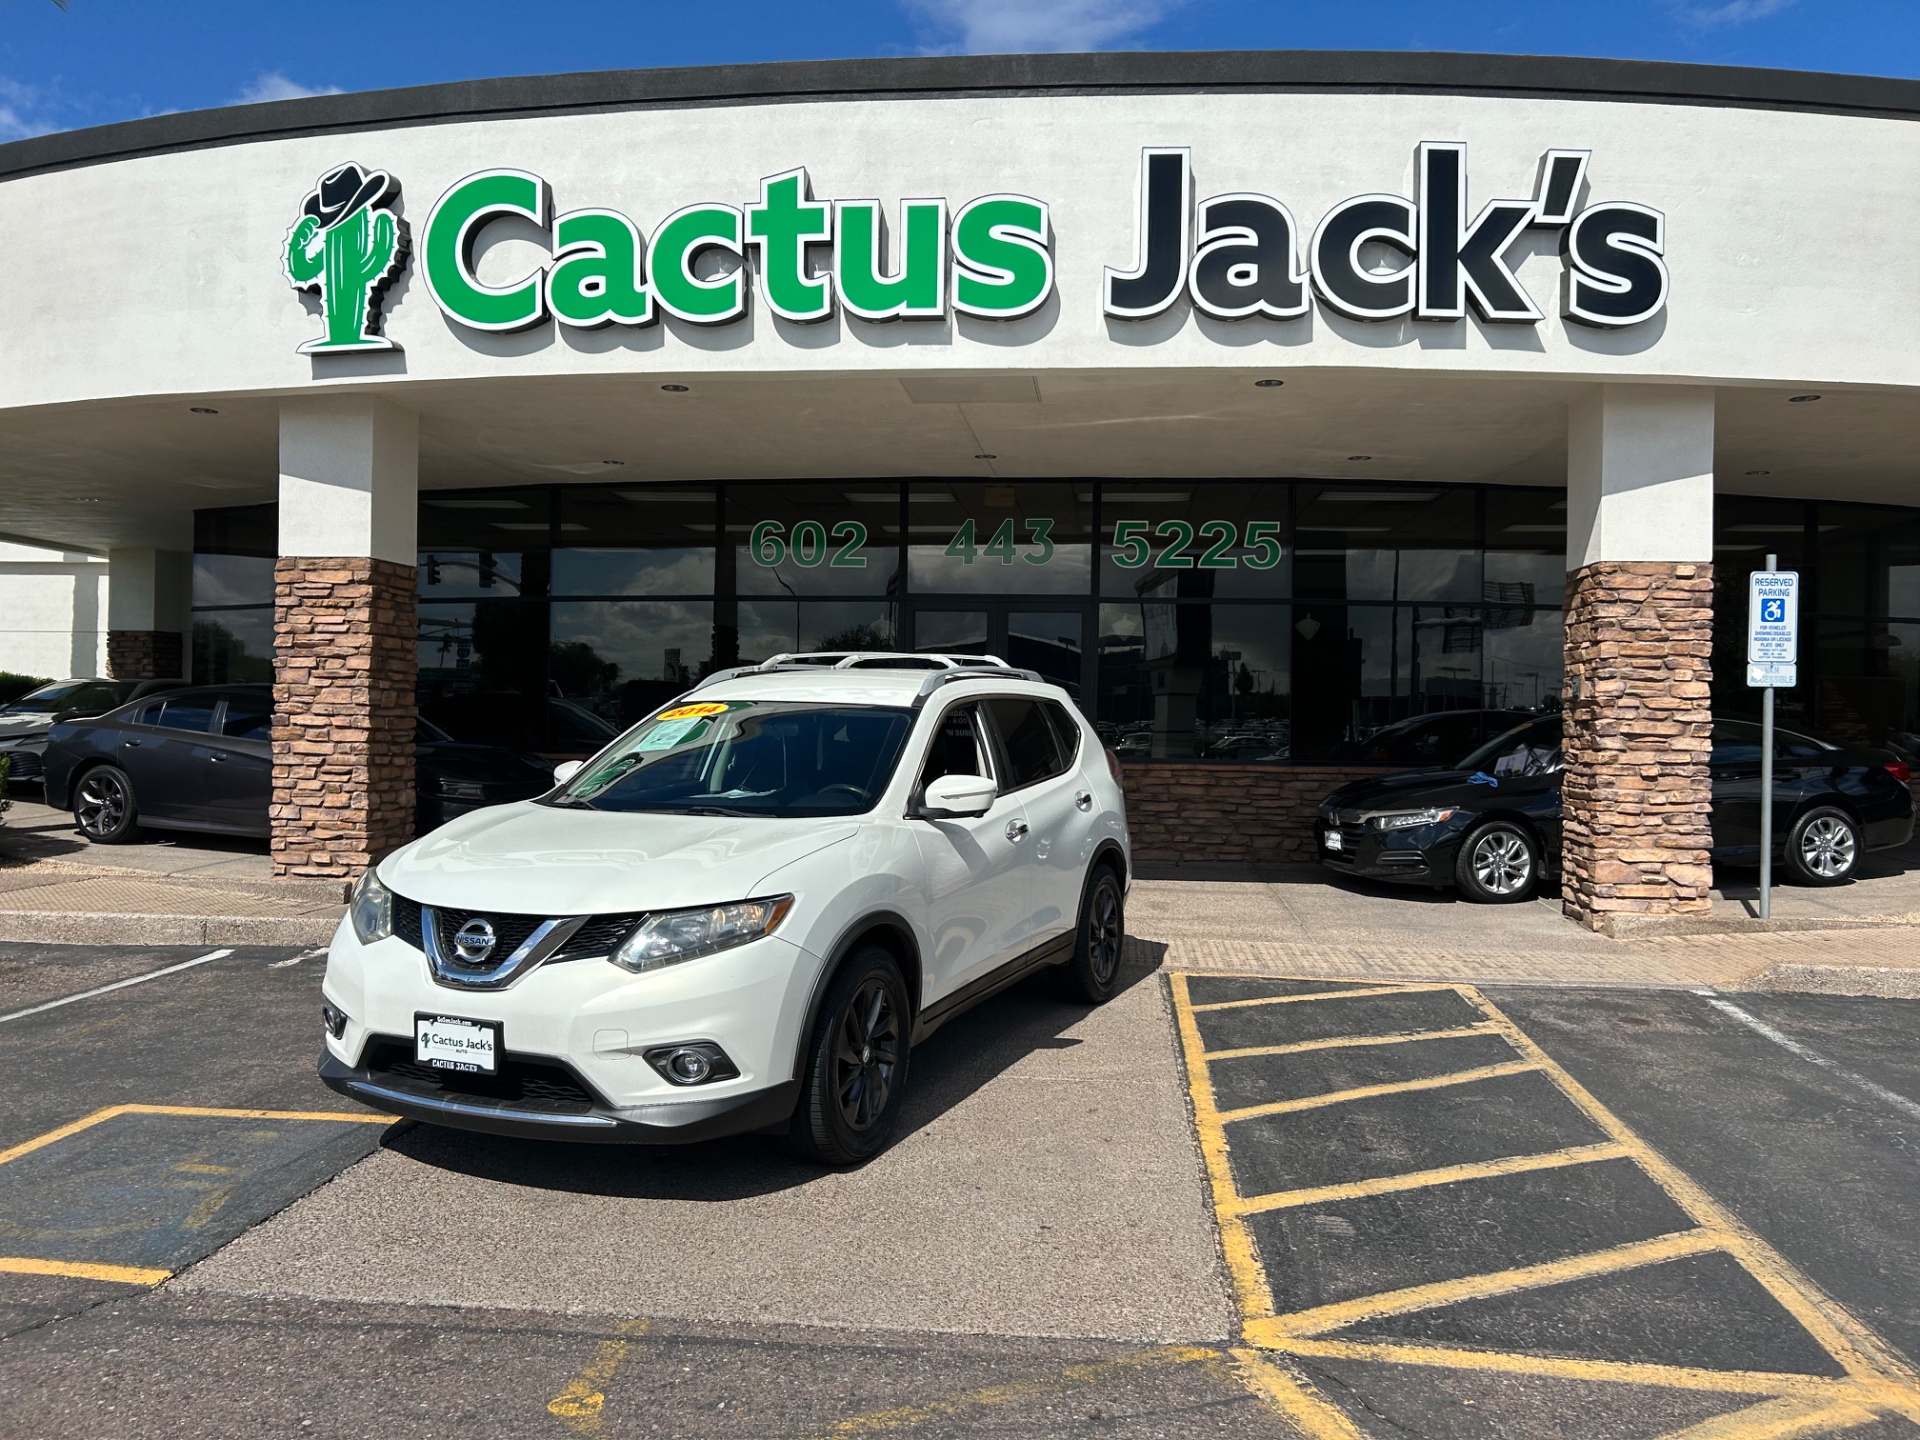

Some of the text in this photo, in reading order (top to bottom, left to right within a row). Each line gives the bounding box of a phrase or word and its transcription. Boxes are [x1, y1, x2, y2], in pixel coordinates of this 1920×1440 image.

[420, 141, 1670, 331] Cactus Jack's
[749, 518, 1282, 569] 602 443 5225
[1755, 578, 1793, 587] RESERVED
[1758, 588, 1790, 597] PARKING
[1765, 666, 1780, 674] VAN
[663, 705, 722, 719] 2014
[456, 935, 490, 946] NISSAN
[432, 1033, 493, 1052] Cactus Jack's
[432, 1059, 455, 1070] CACTUS
